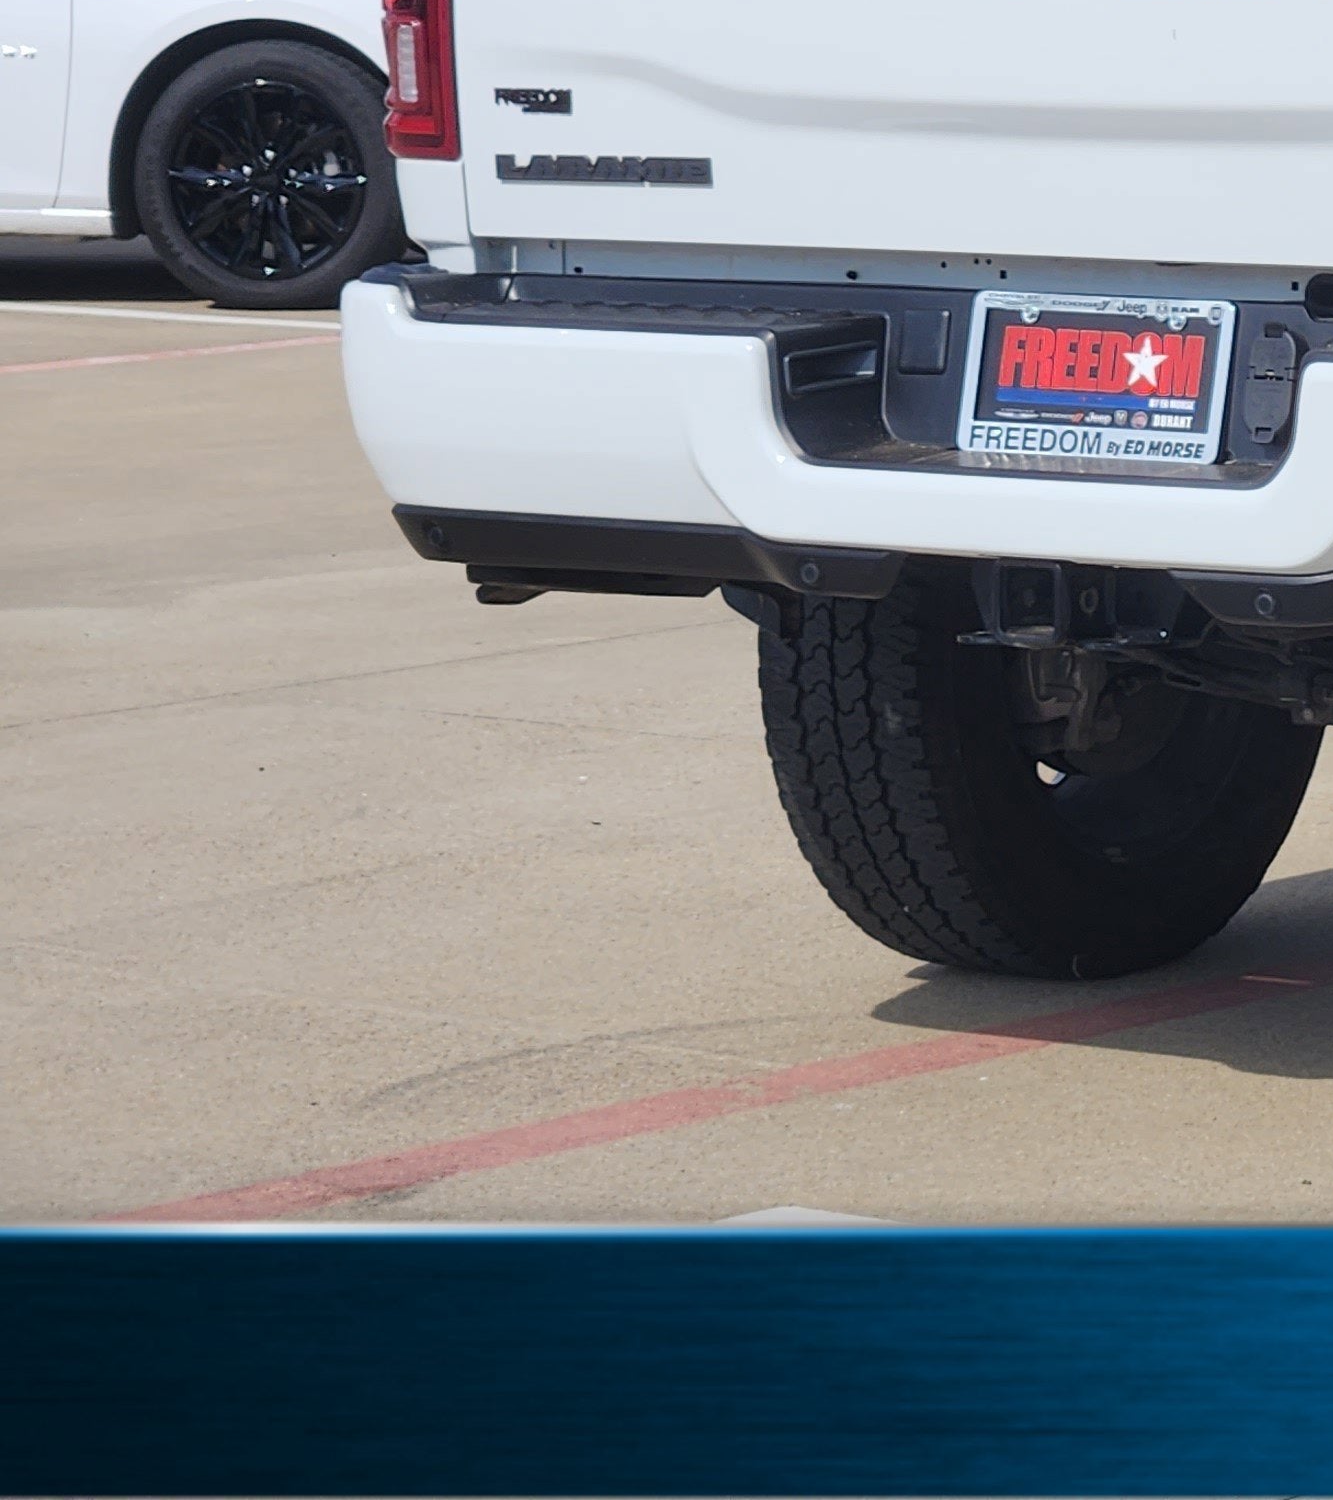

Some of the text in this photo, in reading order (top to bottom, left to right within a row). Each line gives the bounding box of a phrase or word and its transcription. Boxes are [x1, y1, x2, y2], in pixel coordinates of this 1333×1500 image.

[1117, 300, 1148, 317] Jeep
[998, 325, 1206, 398] FREEDOM
[1152, 413, 1194, 430] DURANT
[968, 425, 1103, 455] FREEDOM
[1122, 438, 1144, 456] ED
[1146, 440, 1206, 460] MORSE
